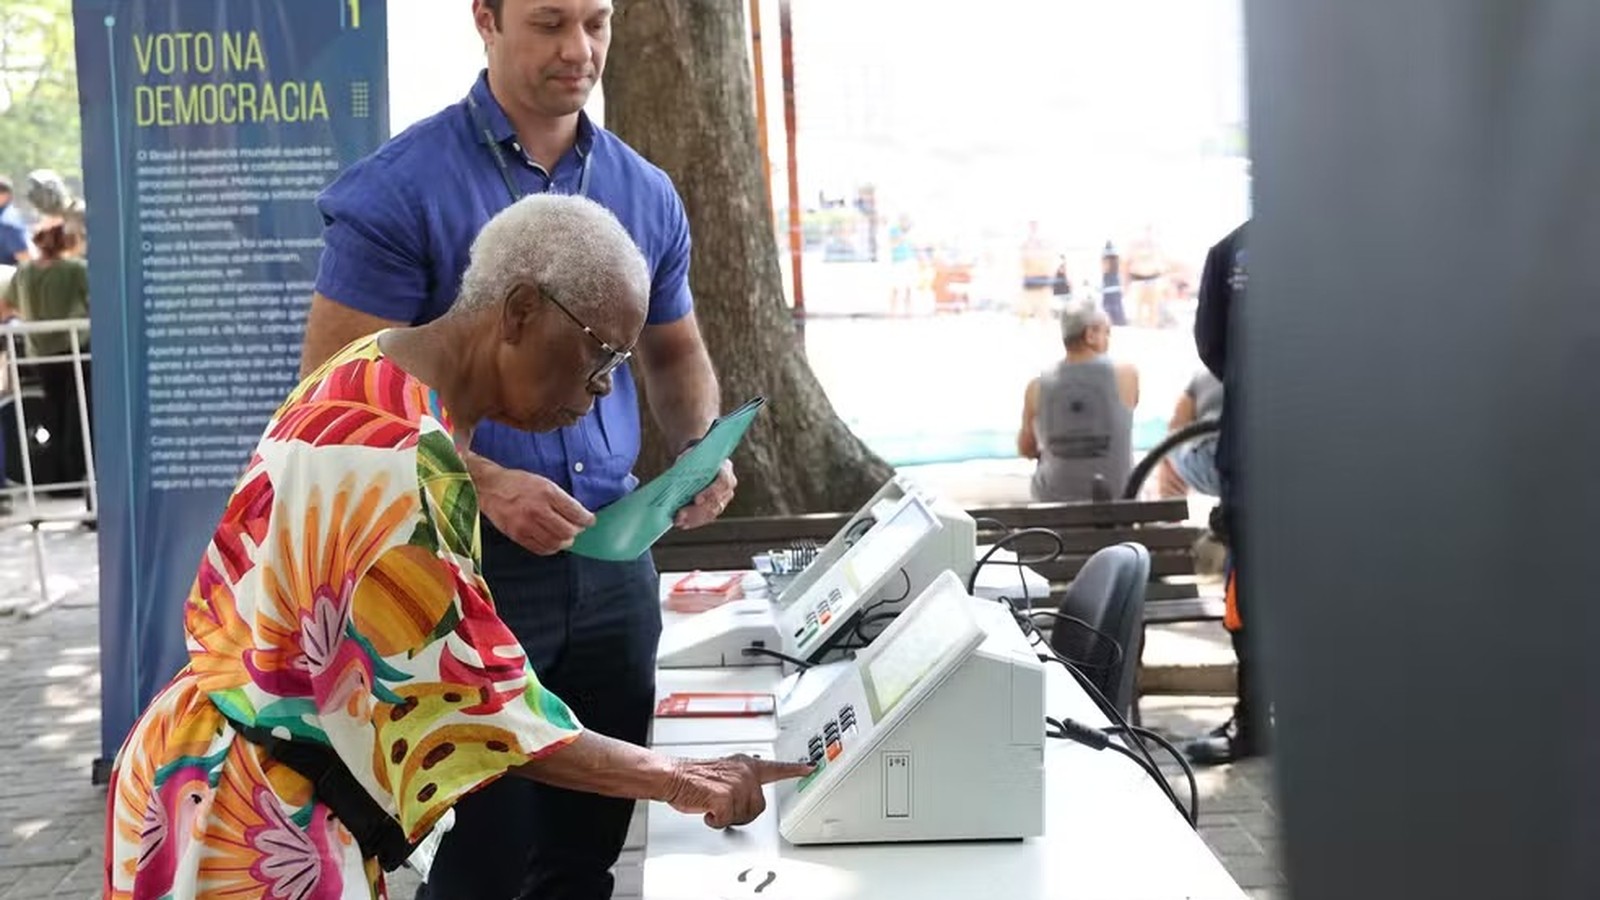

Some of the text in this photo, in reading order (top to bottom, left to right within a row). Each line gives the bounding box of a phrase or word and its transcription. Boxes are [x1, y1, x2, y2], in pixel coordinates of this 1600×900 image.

[133, 31, 265, 74] VOTO NA
[135, 81, 329, 126] DEMOCRACIA
[136, 149, 147, 160] O
[149, 148, 177, 159] Brasil
[188, 147, 237, 159] referência
[240, 146, 280, 157] mundial
[283, 145, 322, 159] quando
[324, 147, 331, 156] o
[137, 163, 177, 174] assunto
[189, 164, 239, 175] segurança
[138, 179, 186, 191] processo
[232, 175, 267, 186] Motivo
[269, 175, 281, 186] de
[284, 174, 325, 188] orgulho
[195, 193, 217, 201] urna
[221, 189, 270, 201] eletrônica
[240, 204, 260, 215] das
[142, 240, 152, 251] O
[154, 242, 172, 250] uso
[175, 239, 187, 250] da
[242, 238, 256, 248] foi
[258, 240, 282, 248] uma
[192, 253, 229, 264] fraudes
[236, 282, 284, 294] processo
[154, 299, 187, 310] seguro
[235, 311, 258, 320] com
[259, 308, 287, 322] sigilo
[168, 327, 185, 336] seu
[186, 324, 210, 335] voto
[222, 324, 235, 334] de
[187, 346, 198, 355] as
[199, 343, 229, 354] teclas
[231, 343, 244, 354] da
[272, 344, 288, 353] no
[253, 357, 266, 367] de
[268, 359, 285, 367] um
[148, 373, 161, 384] de
[229, 371, 248, 382] não
[173, 387, 186, 397] da
[232, 385, 255, 396] Para
[192, 417, 209, 425] um
[151, 435, 173, 446] Com
[188, 448, 200, 459] de
[151, 466, 167, 474] um
[168, 463, 187, 474] dos
